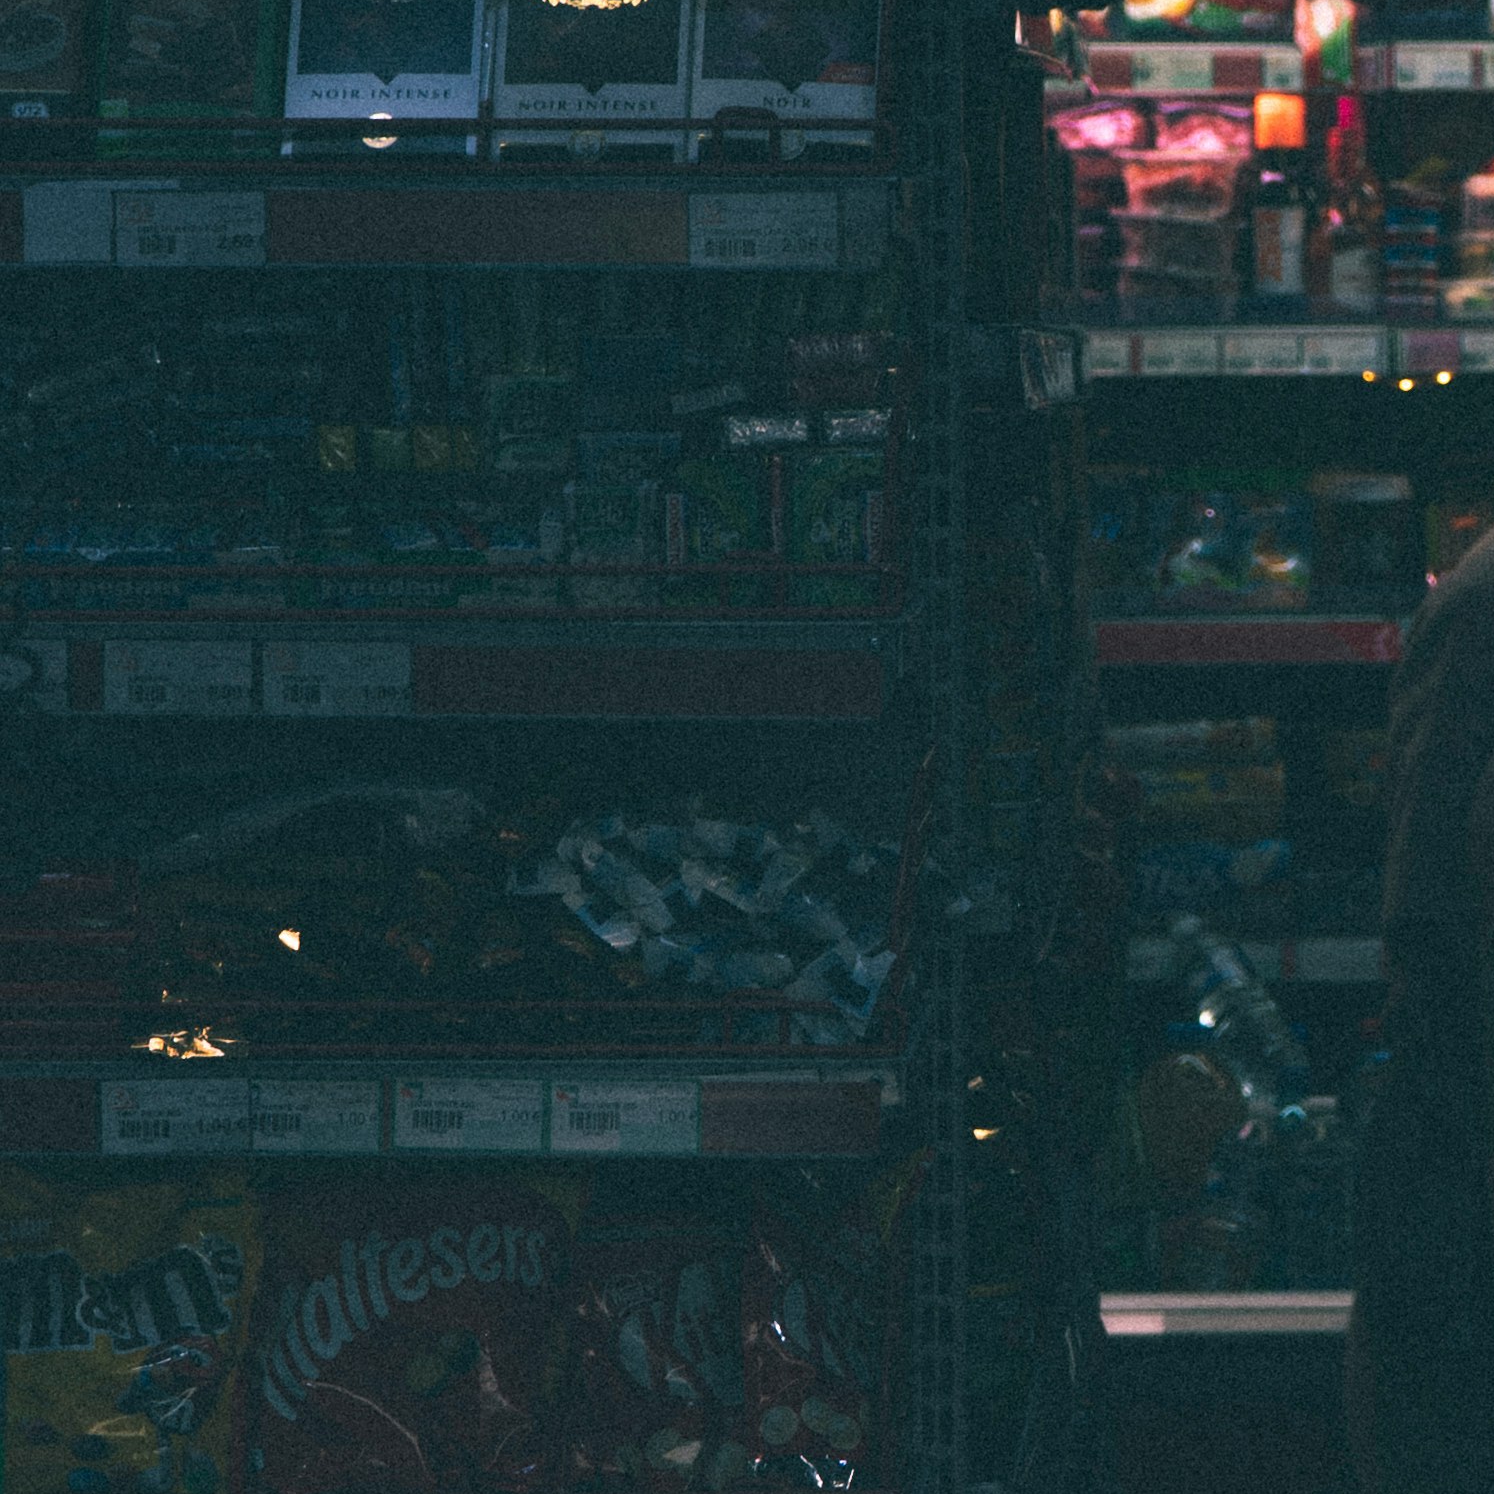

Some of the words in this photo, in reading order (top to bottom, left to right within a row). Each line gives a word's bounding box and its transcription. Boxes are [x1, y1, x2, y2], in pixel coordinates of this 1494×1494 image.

[308, 87, 360, 100] NOIR
[367, 87, 448, 101] INTENSE
[517, 99, 567, 112] NOIR
[574, 99, 655, 113] INTENSE
[760, 96, 811, 108] NOIR
